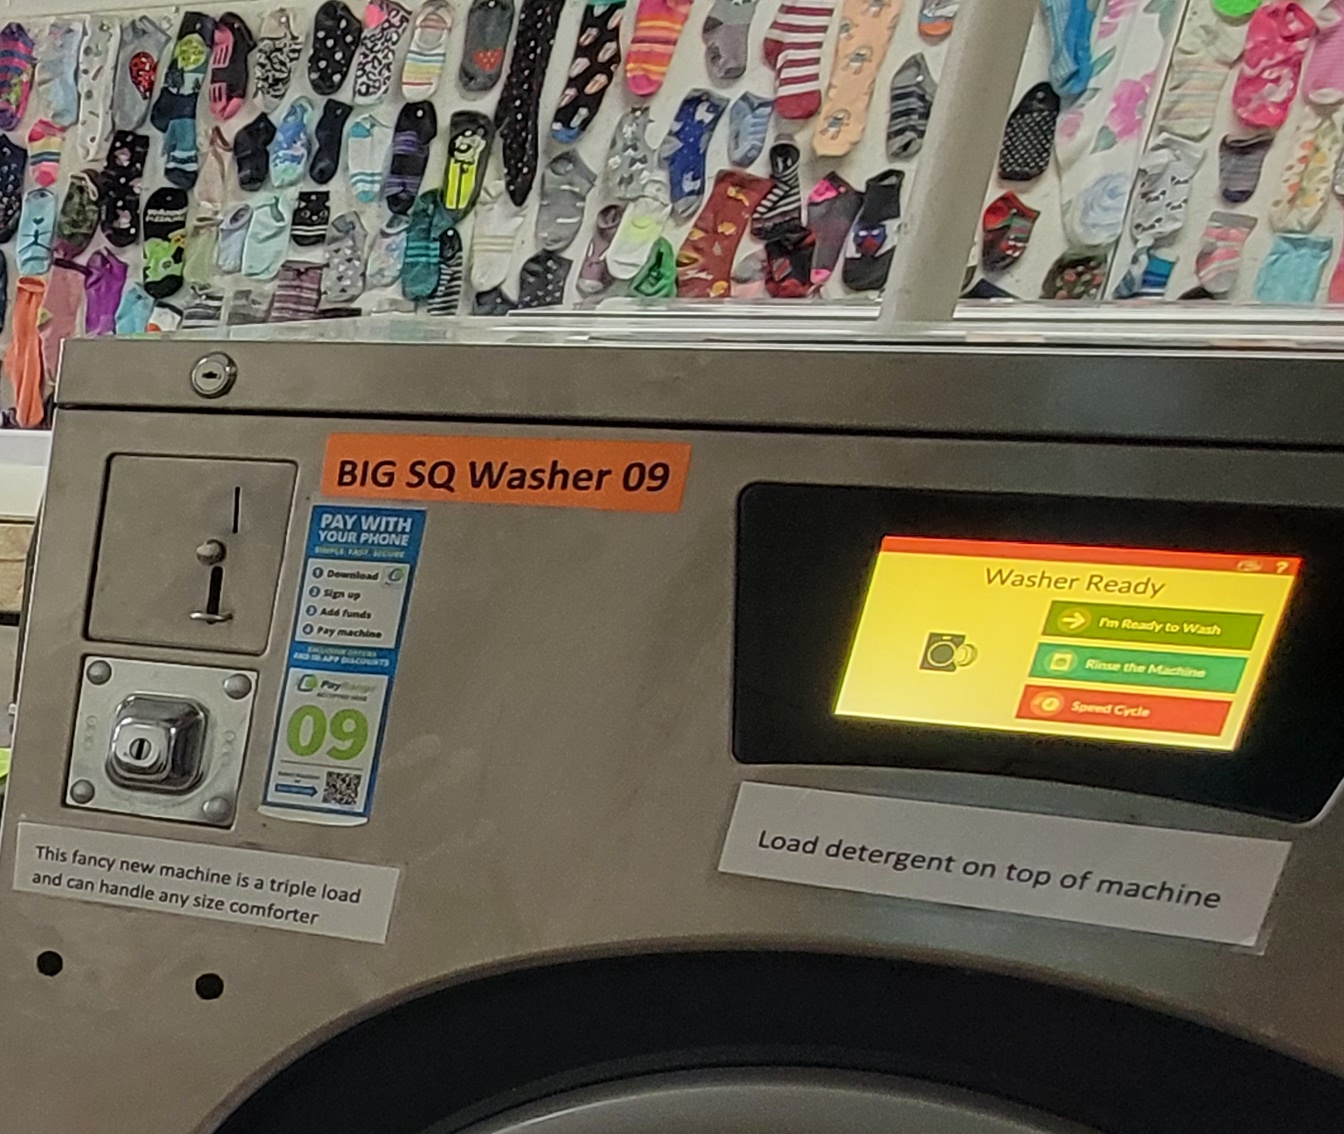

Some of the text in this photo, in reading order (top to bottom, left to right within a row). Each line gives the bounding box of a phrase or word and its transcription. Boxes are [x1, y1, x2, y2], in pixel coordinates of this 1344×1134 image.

[337, 459, 670, 493] BIG SQ Washer 09
[320, 514, 412, 533] PAY WITH
[318, 530, 410, 547] YOUR PHONE
[327, 569, 379, 581] Download
[985, 567, 1166, 599] Washer Ready
[323, 589, 345, 600] Sign
[347, 591, 361, 602] up
[320, 608, 340, 617] Add
[342, 608, 372, 619] funds
[317, 626, 335, 637] Pay
[337, 628, 382, 639] machine
[1099, 616, 1221, 637] I'm Ready to Wash
[1085, 659, 1206, 679] Rinse the Machine
[1071, 701, 1151, 719] Speed Cycle
[286, 704, 369, 761] 09
[35, 845, 362, 904] This fancy new machine is a triple load
[757, 829, 1222, 910] Load detergent on top of machine
[32, 870, 320, 926] and can handle any size comforter
